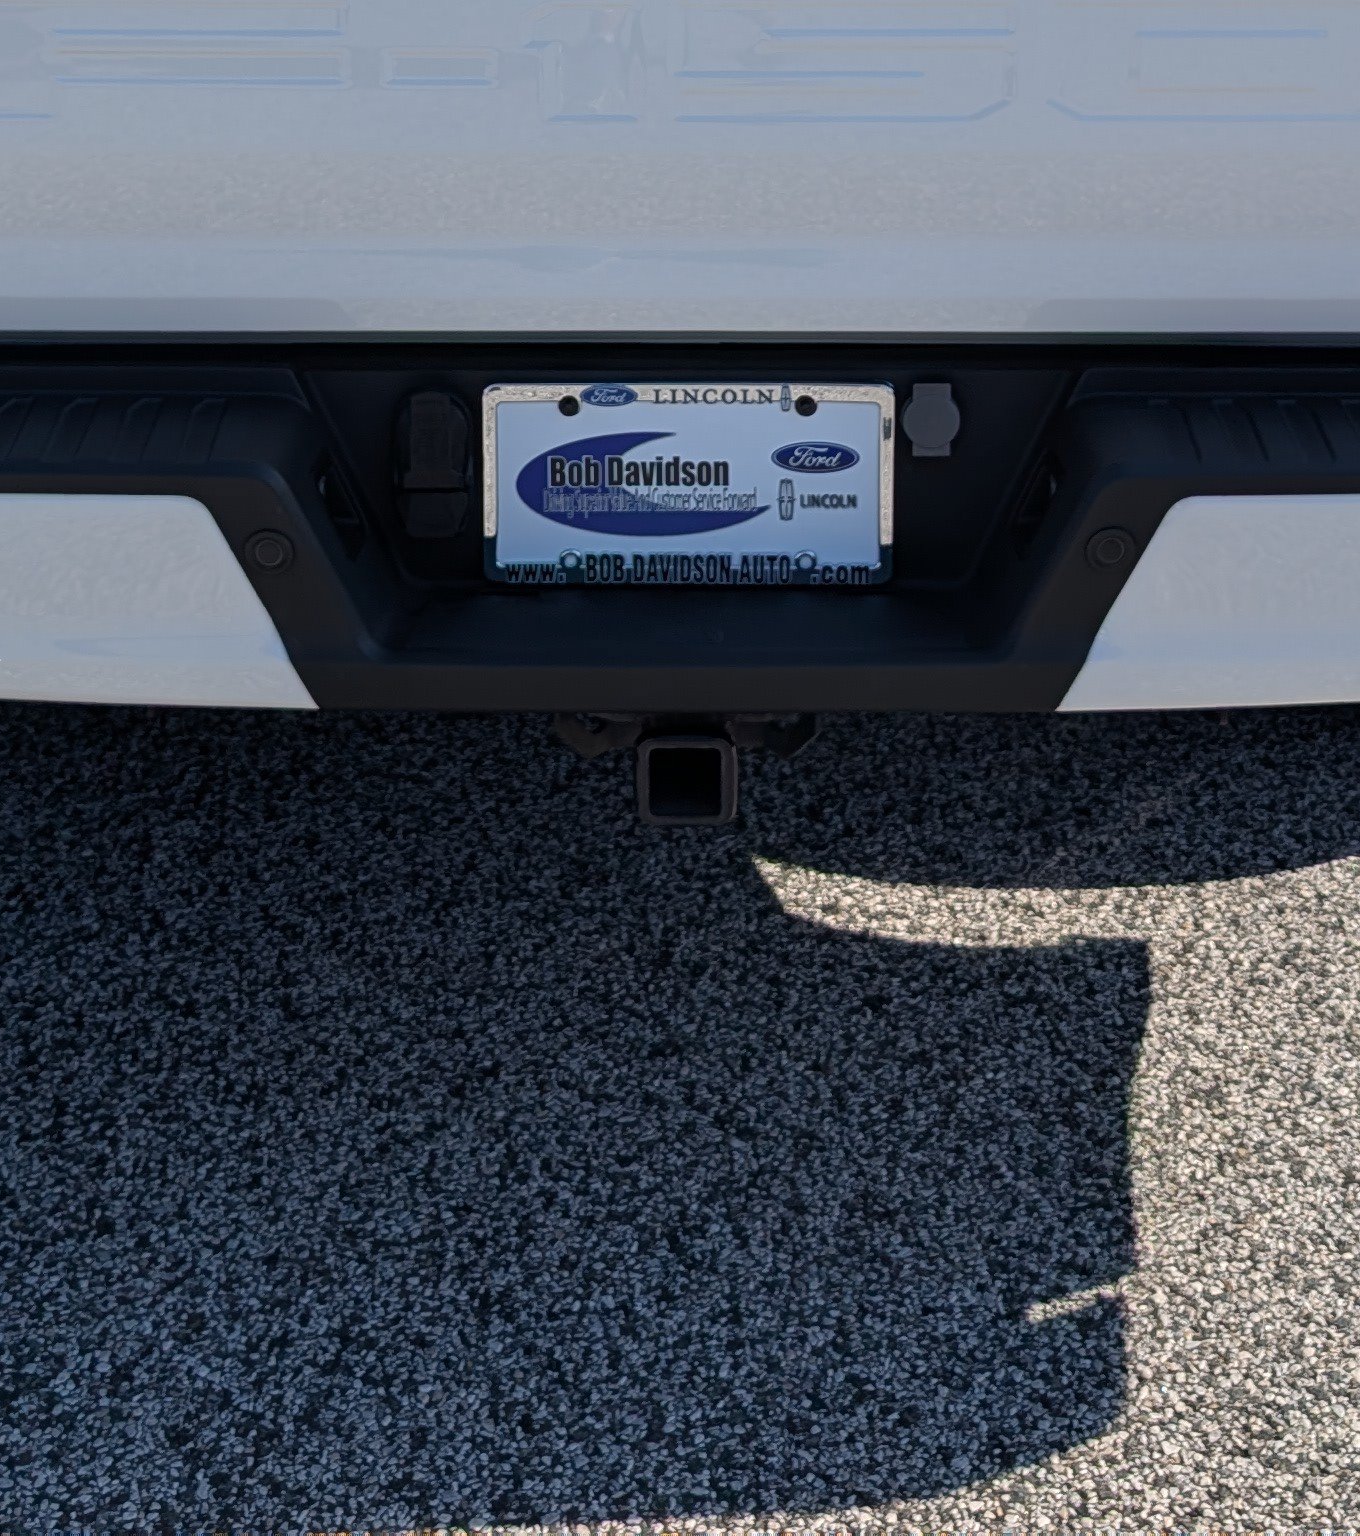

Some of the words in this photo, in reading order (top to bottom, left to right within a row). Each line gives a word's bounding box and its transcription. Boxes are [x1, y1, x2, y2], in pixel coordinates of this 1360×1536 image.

[589, 386, 628, 405] Ford
[653, 388, 774, 405] LINCOLN
[788, 446, 842, 468] Ford
[549, 455, 600, 487] Bob
[606, 455, 730, 487] Davidson
[799, 493, 857, 510] LINCOLN
[584, 553, 627, 583] BOB
[632, 553, 732, 583] DAVIDSON
[739, 553, 791, 583] AUTO
